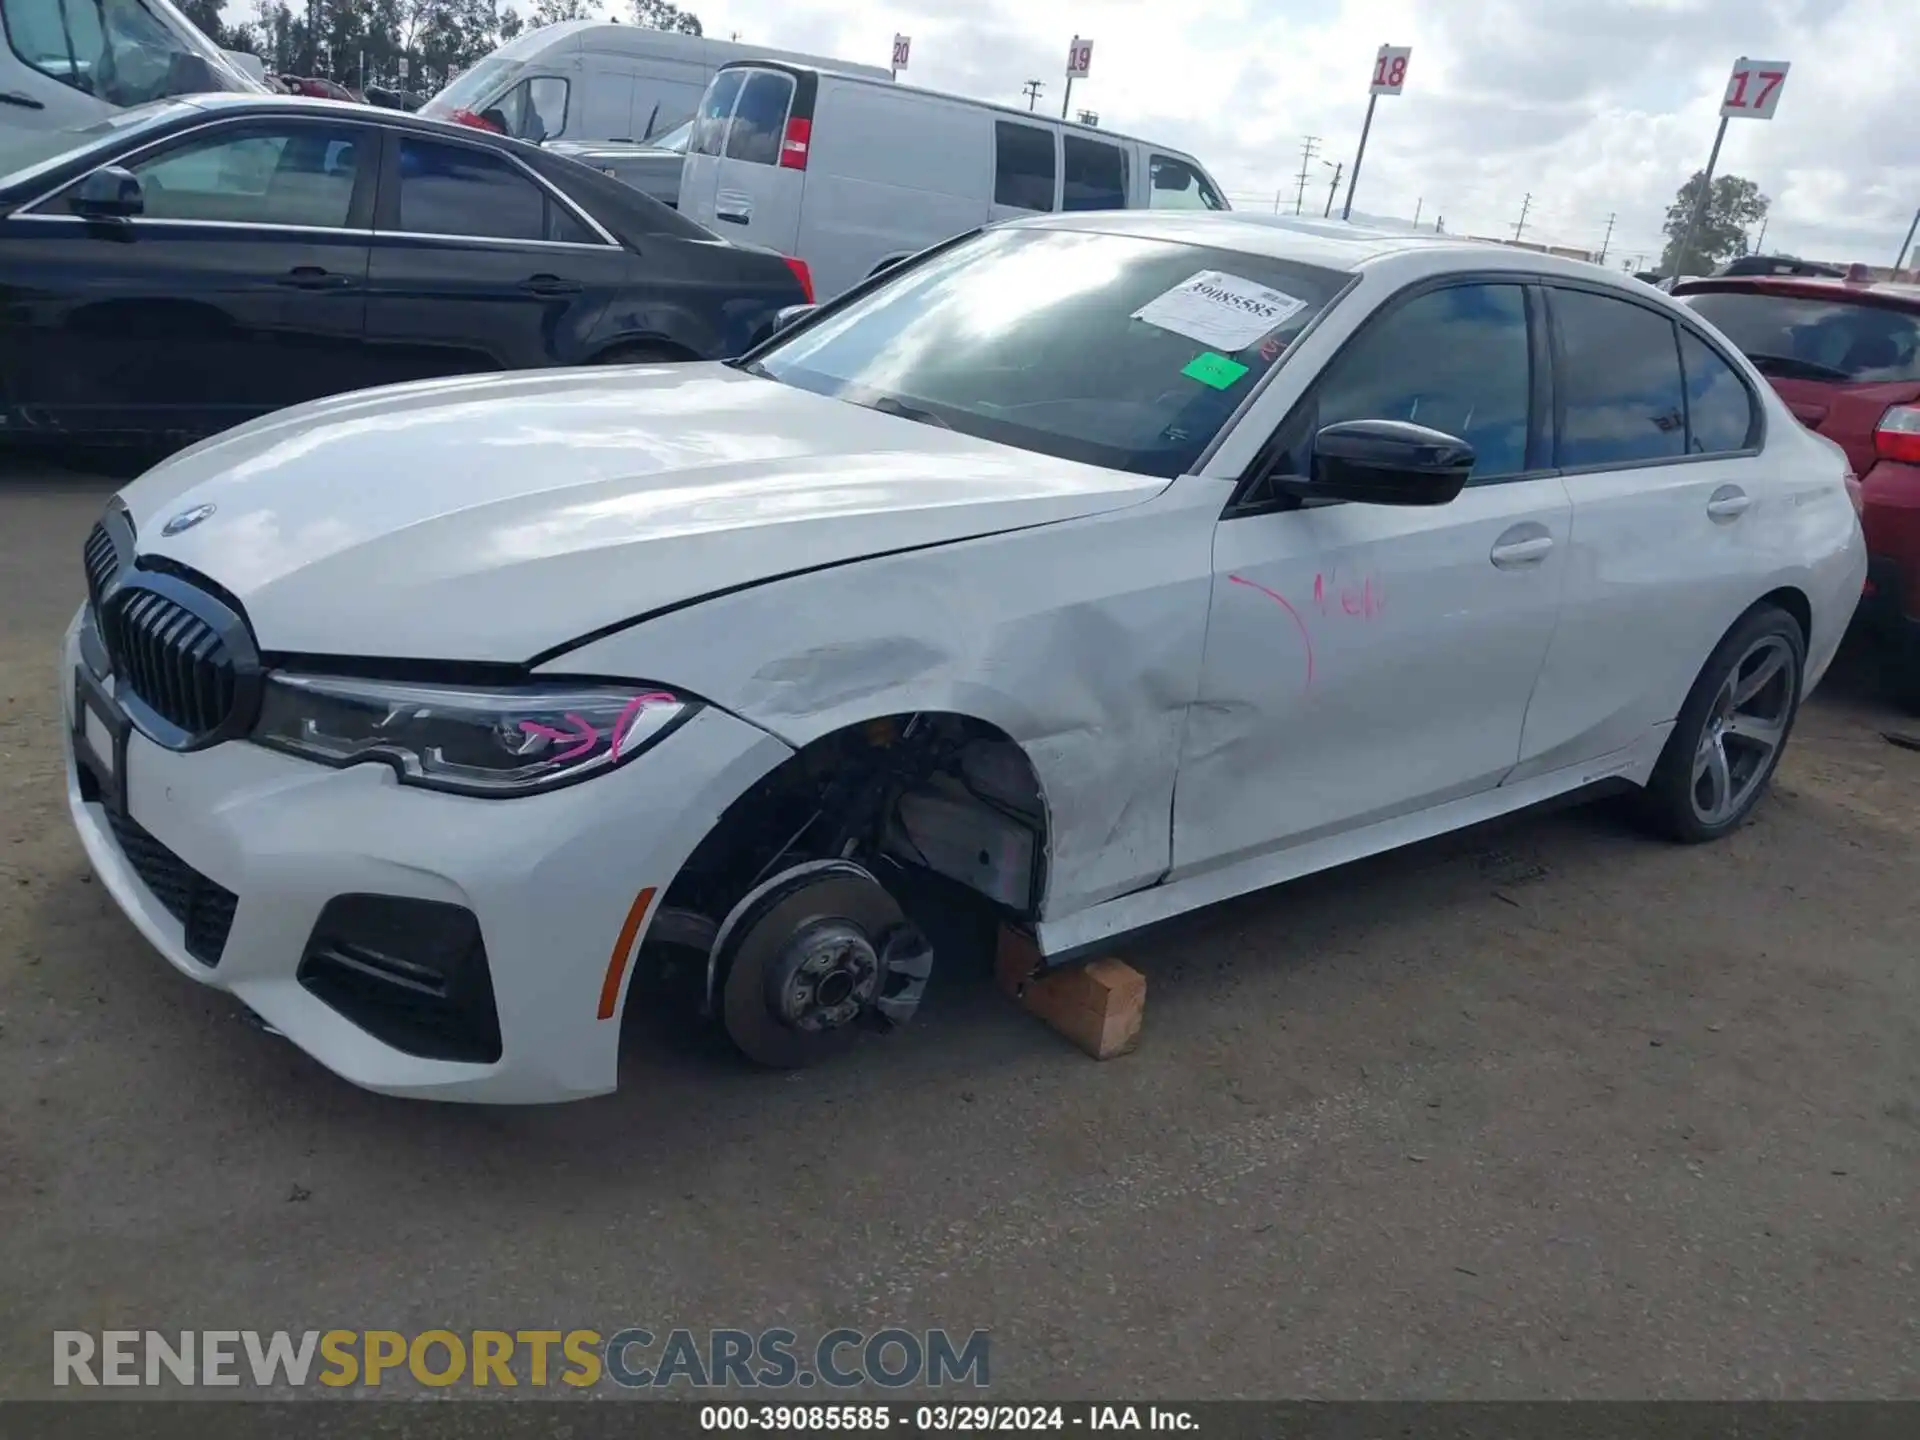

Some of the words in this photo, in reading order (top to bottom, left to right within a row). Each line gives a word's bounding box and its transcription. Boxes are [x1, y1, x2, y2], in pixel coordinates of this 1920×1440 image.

[893, 43, 909, 64] 20
[1068, 48, 1091, 71] 19
[1373, 56, 1407, 87] 18
[1725, 70, 1786, 109] 17
